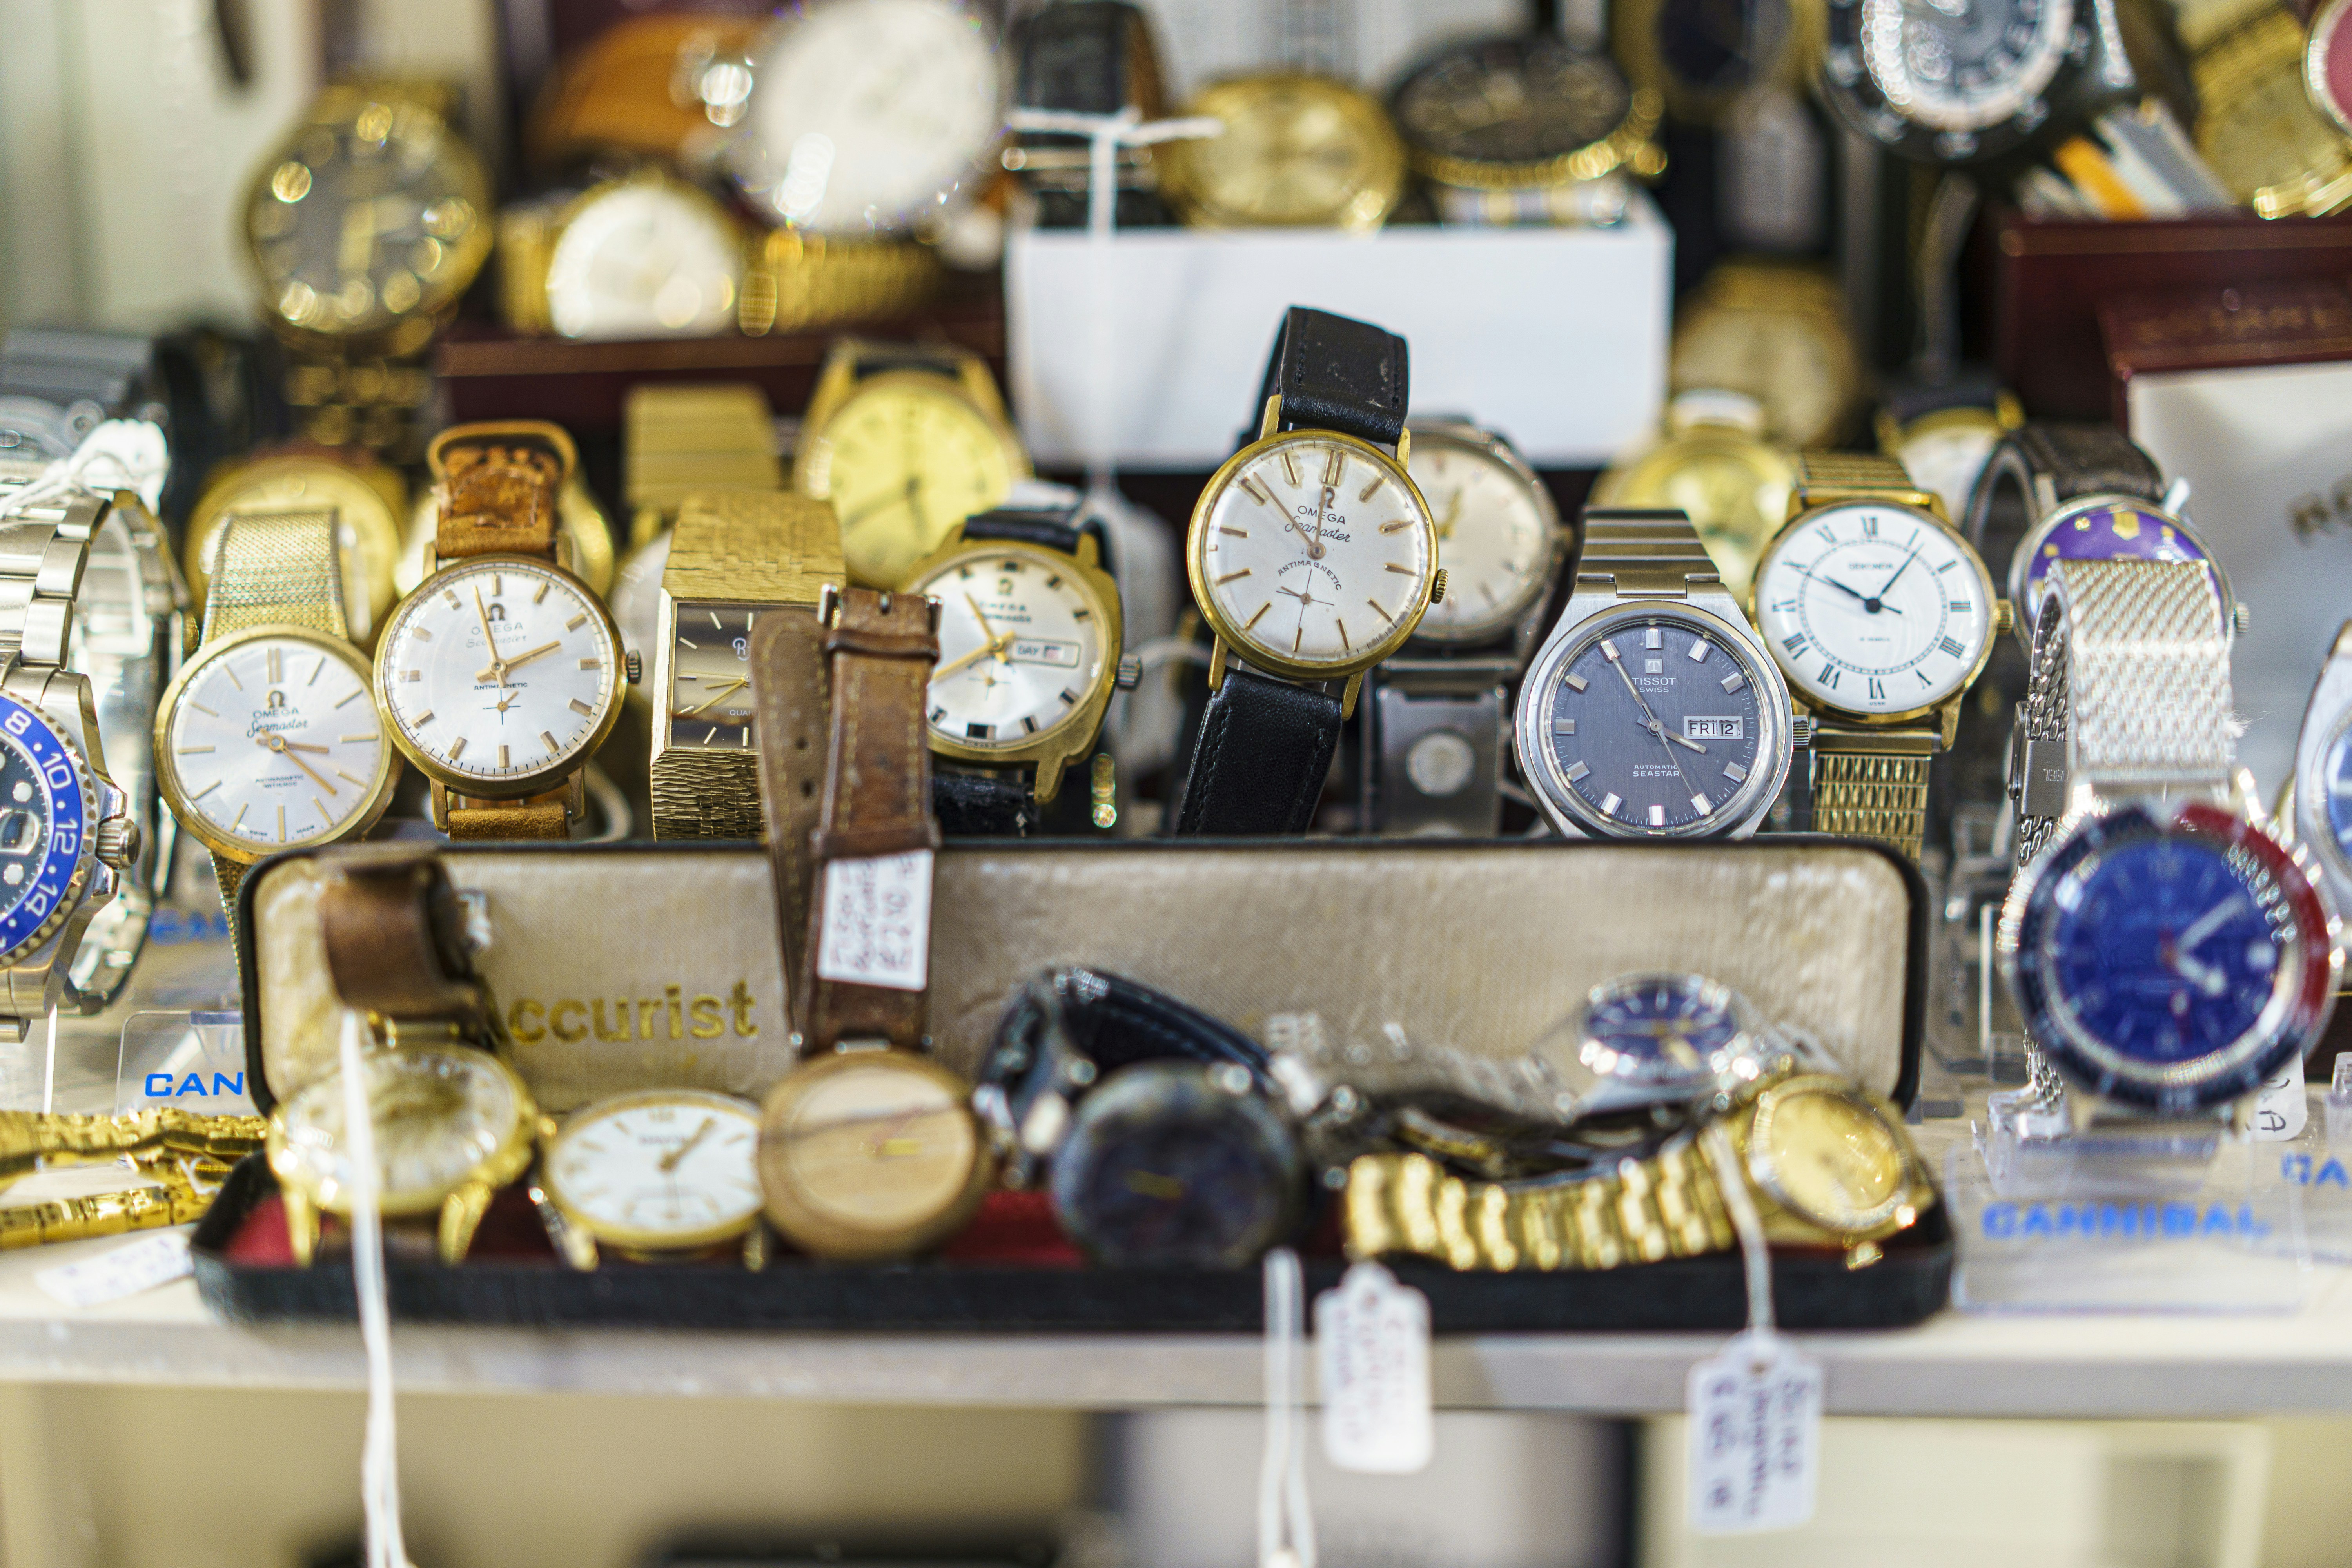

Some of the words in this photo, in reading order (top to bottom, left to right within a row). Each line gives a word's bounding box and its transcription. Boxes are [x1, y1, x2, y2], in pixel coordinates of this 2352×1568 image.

[1298, 506, 1345, 525] OMEGA
[1285, 516, 1351, 542] Seamaster
[1278, 560, 1342, 590] ANTIMAGNETIC
[1849, 562, 1893, 571] SEKONDA
[471, 622, 523, 635] OEGA
[466, 635, 527, 648] Seaaster
[1632, 677, 1676, 686] TISSOT
[5, 711, 32, 735] 8
[253, 707, 299, 719] OMEGA
[246, 719, 309, 738] Seamaster
[1690, 723, 1715, 734] FRI
[1721, 724, 1733, 735] 12
[42, 753, 72, 789] 10
[53, 818, 78, 855] 12
[25, 882, 58, 918] 14
[509, 980, 759, 1046] ccurist
[145, 1071, 244, 1097] CAN
[1981, 1200, 2272, 1240] CANNIBAL
